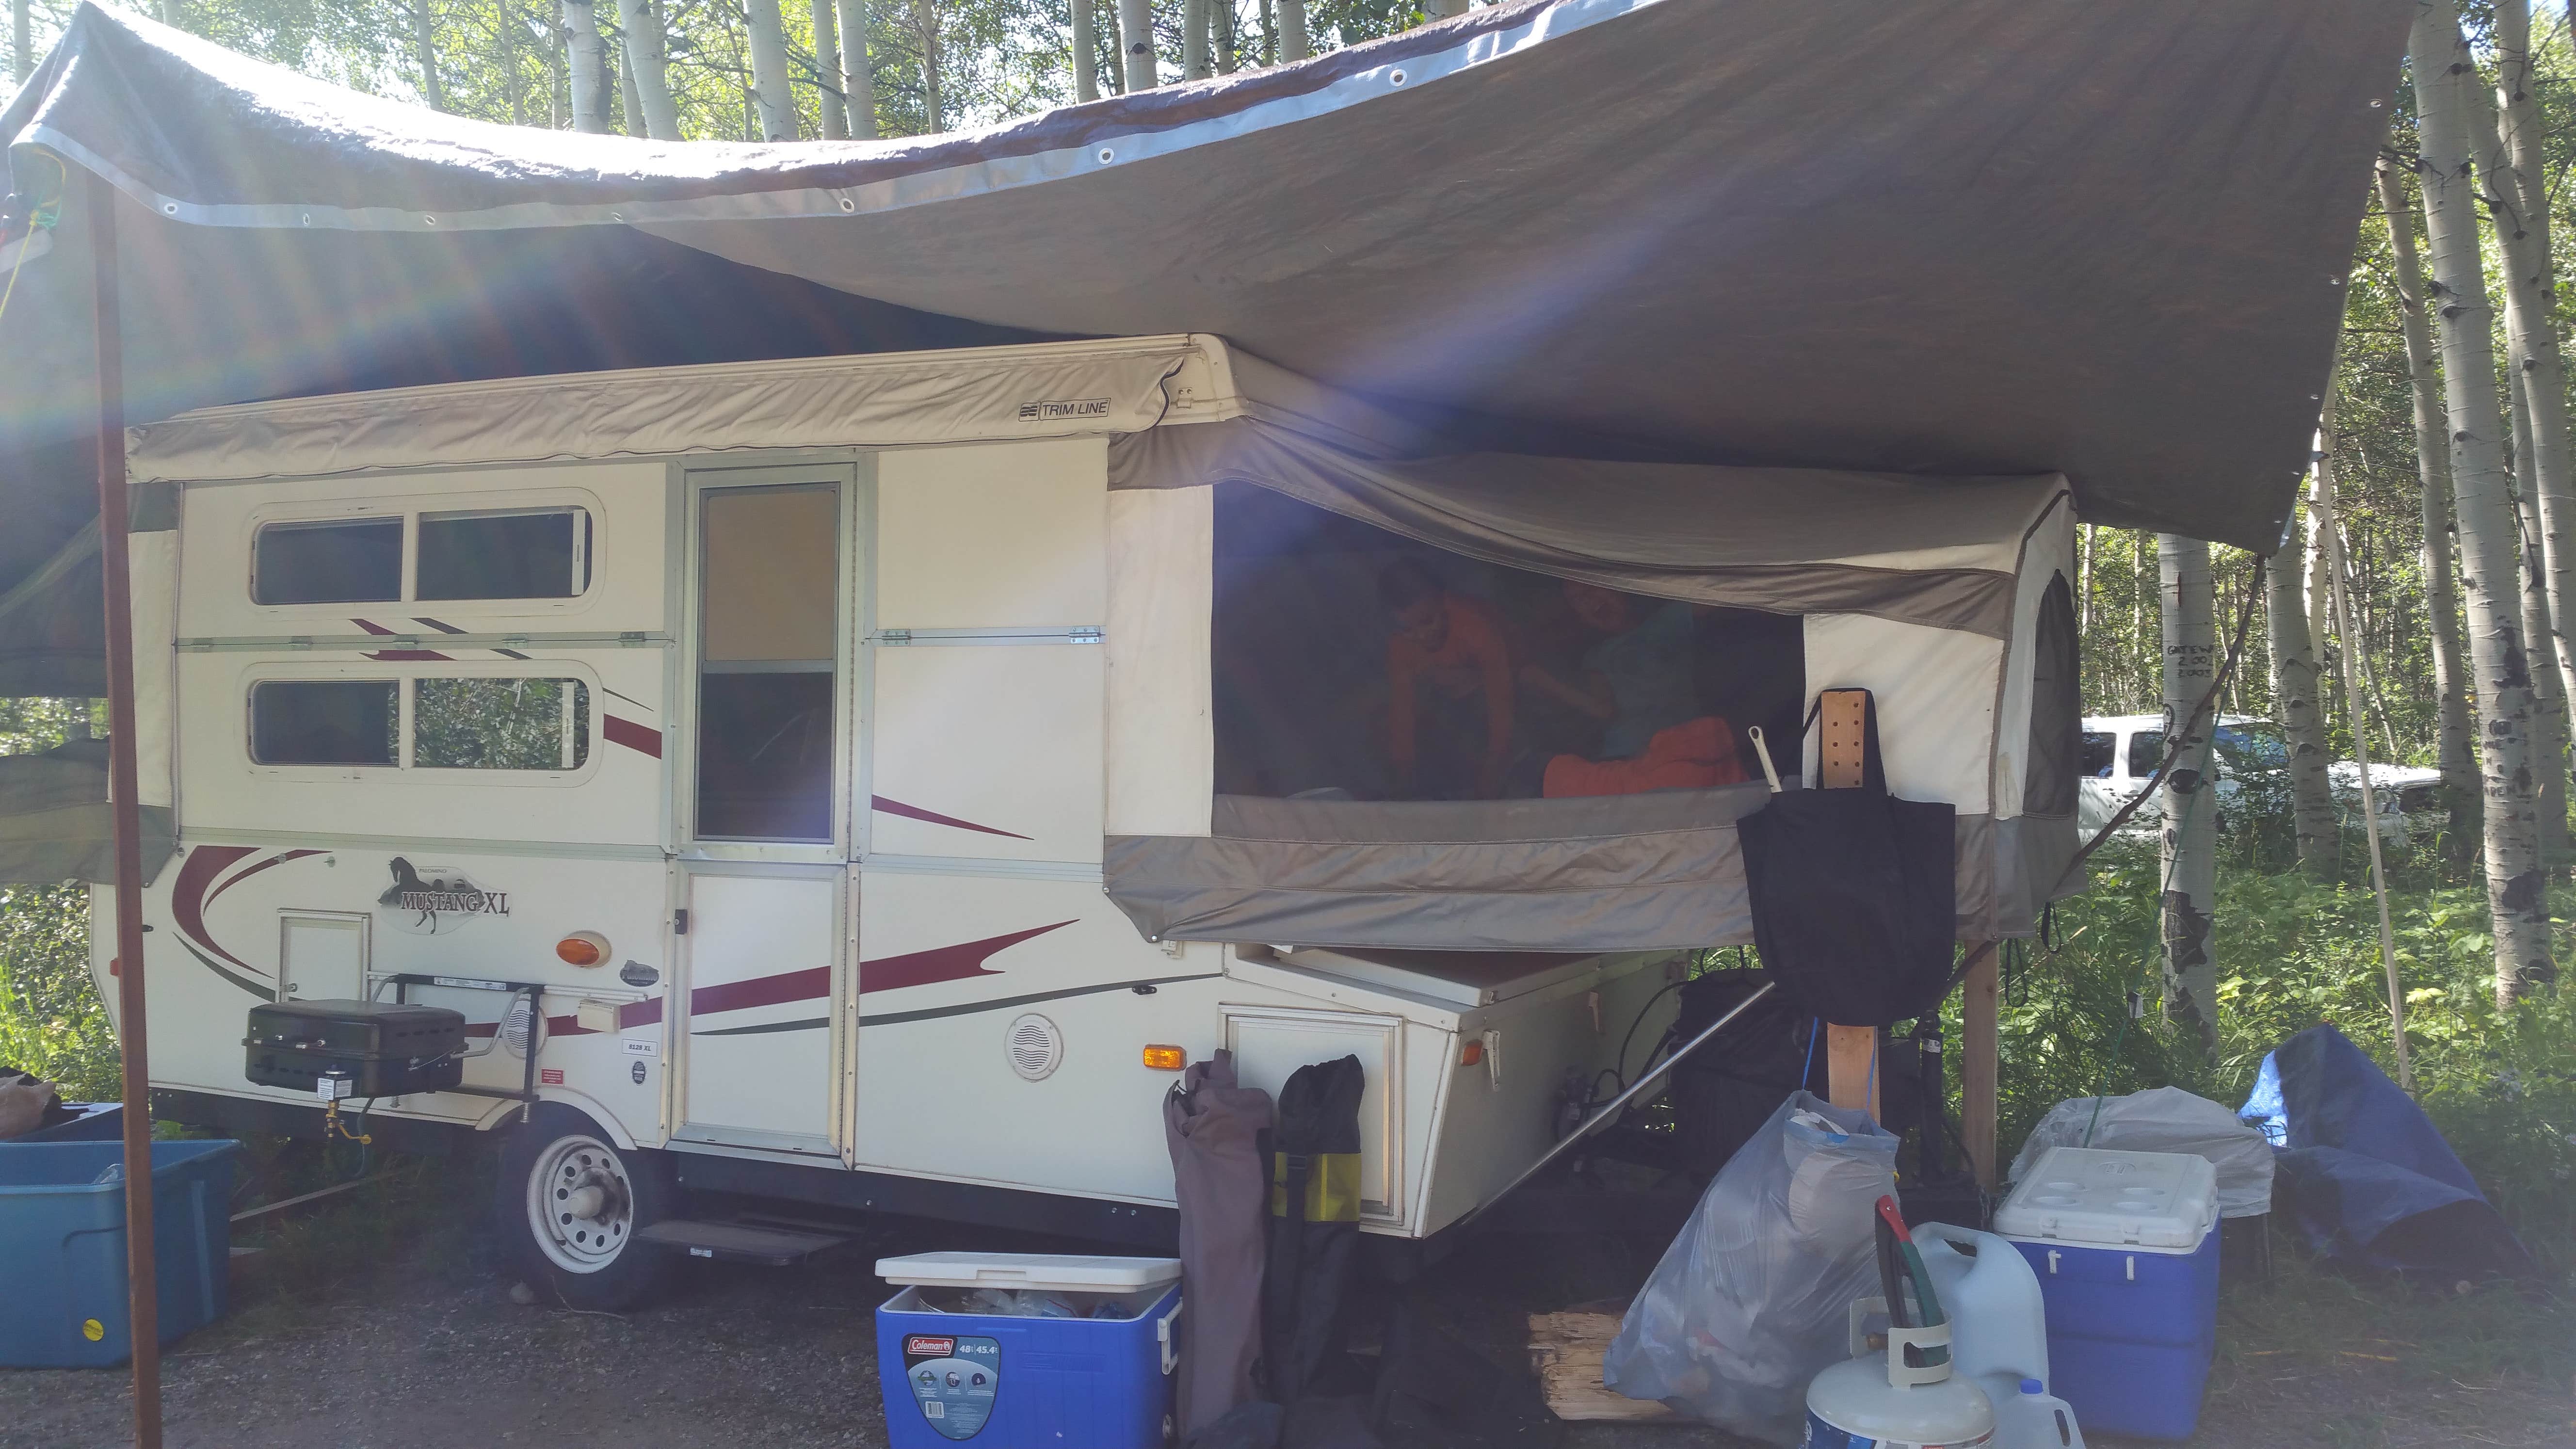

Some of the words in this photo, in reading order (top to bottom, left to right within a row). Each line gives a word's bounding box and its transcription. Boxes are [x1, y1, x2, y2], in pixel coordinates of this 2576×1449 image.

[1042, 403, 1074, 416] TRIM
[1078, 402, 1108, 414] LINE
[401, 892, 479, 912] MUSTANG
[483, 892, 510, 917] XL
[912, 1339, 943, 1350] Coleman
[959, 1345, 971, 1353] 48
[976, 1346, 995, 1354] 45.4
